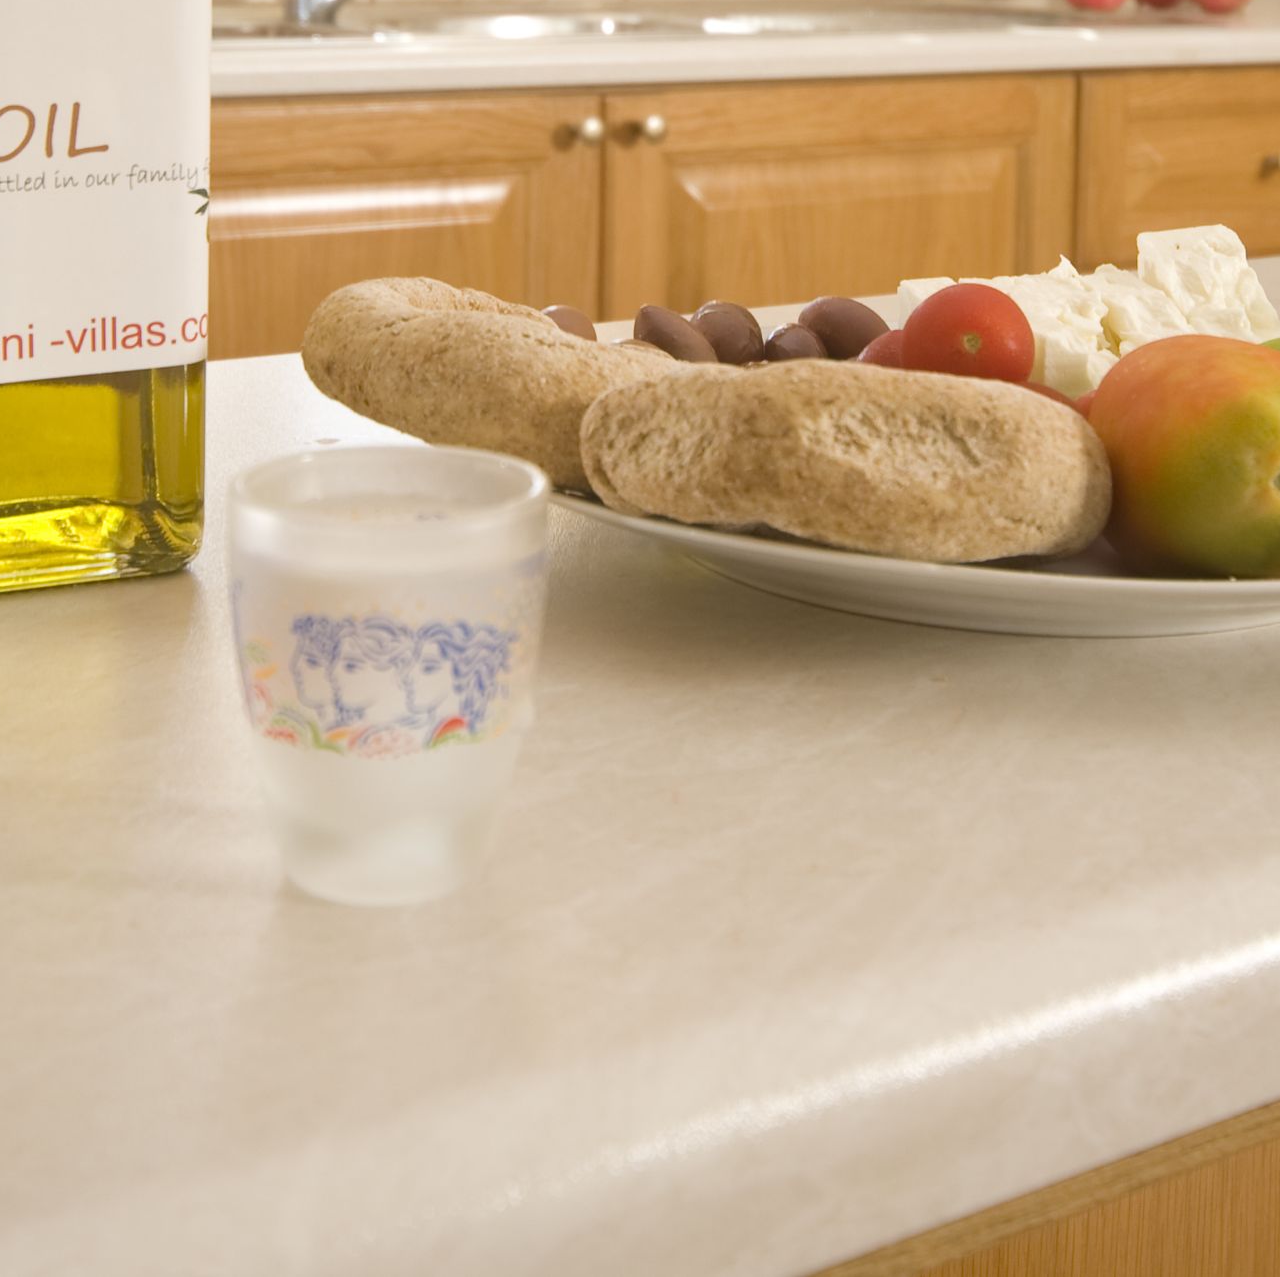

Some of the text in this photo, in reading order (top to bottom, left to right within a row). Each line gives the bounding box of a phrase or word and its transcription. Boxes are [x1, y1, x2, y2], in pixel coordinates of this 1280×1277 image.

[53, 169, 78, 190] in
[84, 171, 121, 190] our
[126, 162, 199, 191] family
